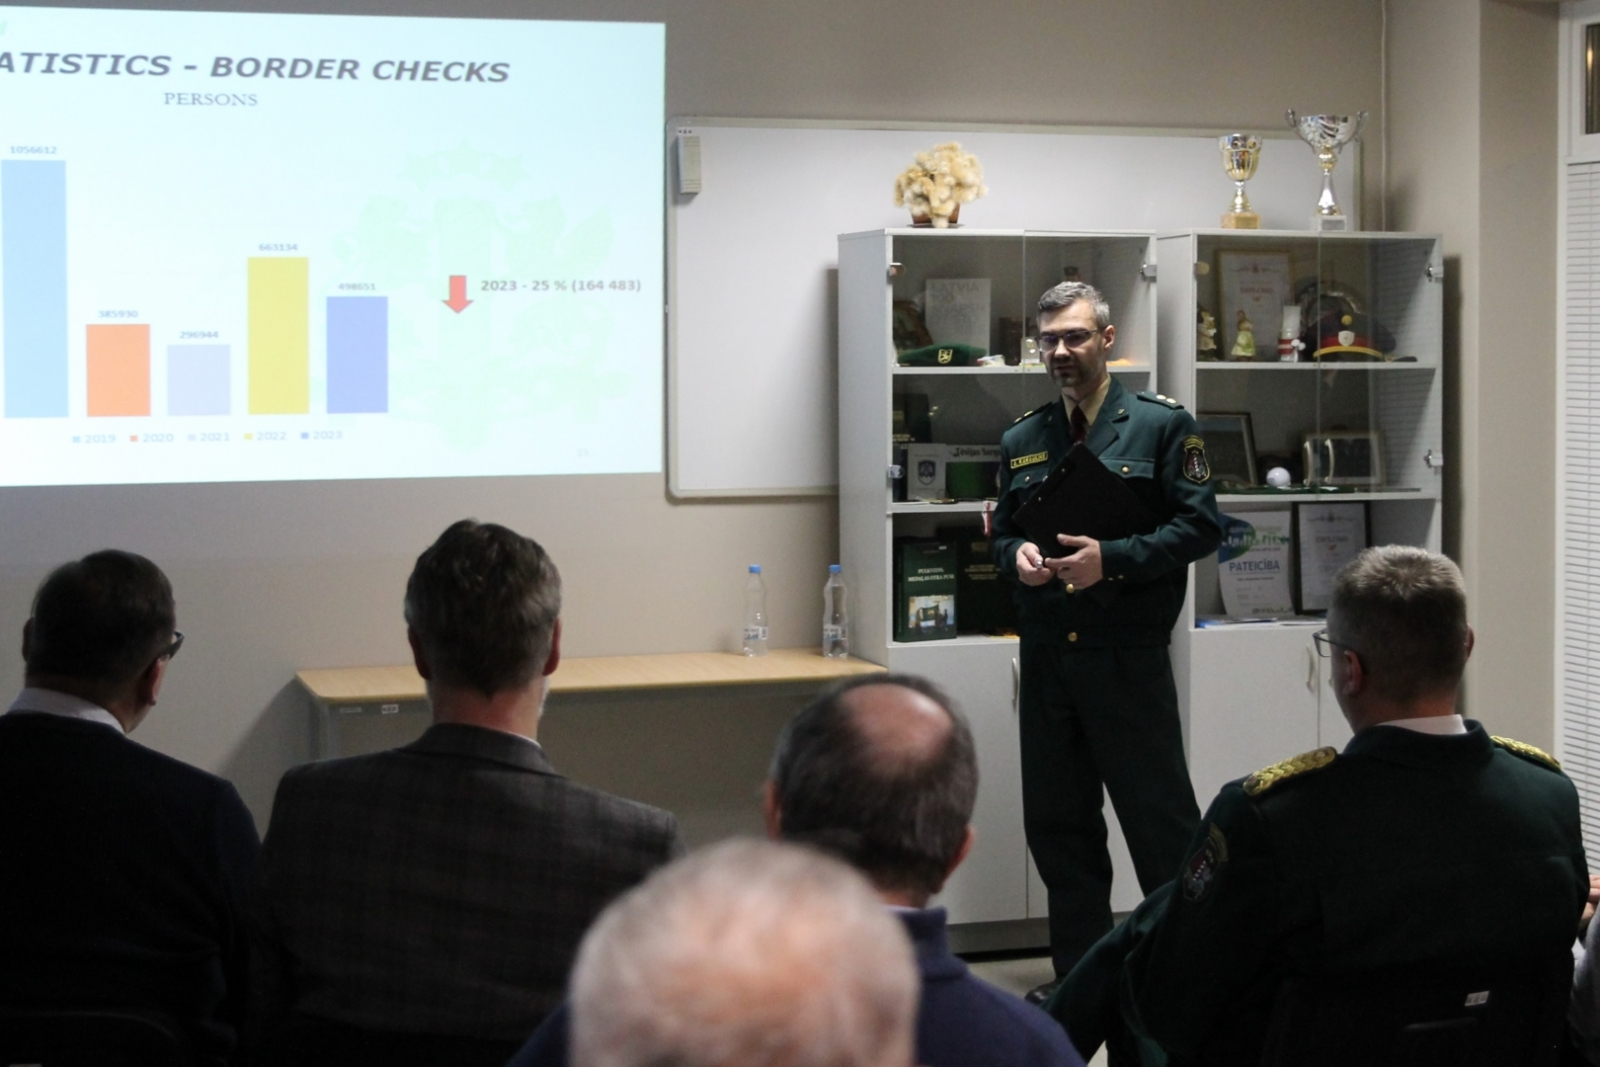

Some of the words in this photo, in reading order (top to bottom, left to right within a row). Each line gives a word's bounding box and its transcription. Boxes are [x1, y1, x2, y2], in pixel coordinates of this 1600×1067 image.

[210, 56, 361, 80] BORDER
[372, 59, 511, 83] CHECKS
[164, 92, 259, 107] PERSONS
[9, 145, 58, 155] 1056612
[258, 243, 299, 252] 663134
[338, 282, 377, 291] 498651
[480, 279, 518, 292] 2023
[531, 279, 550, 292] 25
[554, 279, 568, 292] %
[571, 278, 605, 294] (164
[608, 278, 642, 294] 483)
[179, 330, 220, 339] 296944
[84, 433, 117, 444] 2019
[142, 432, 175, 443] 2020
[199, 432, 230, 442] 2021
[256, 431, 287, 441] 2022
[312, 430, 343, 440] 2023
